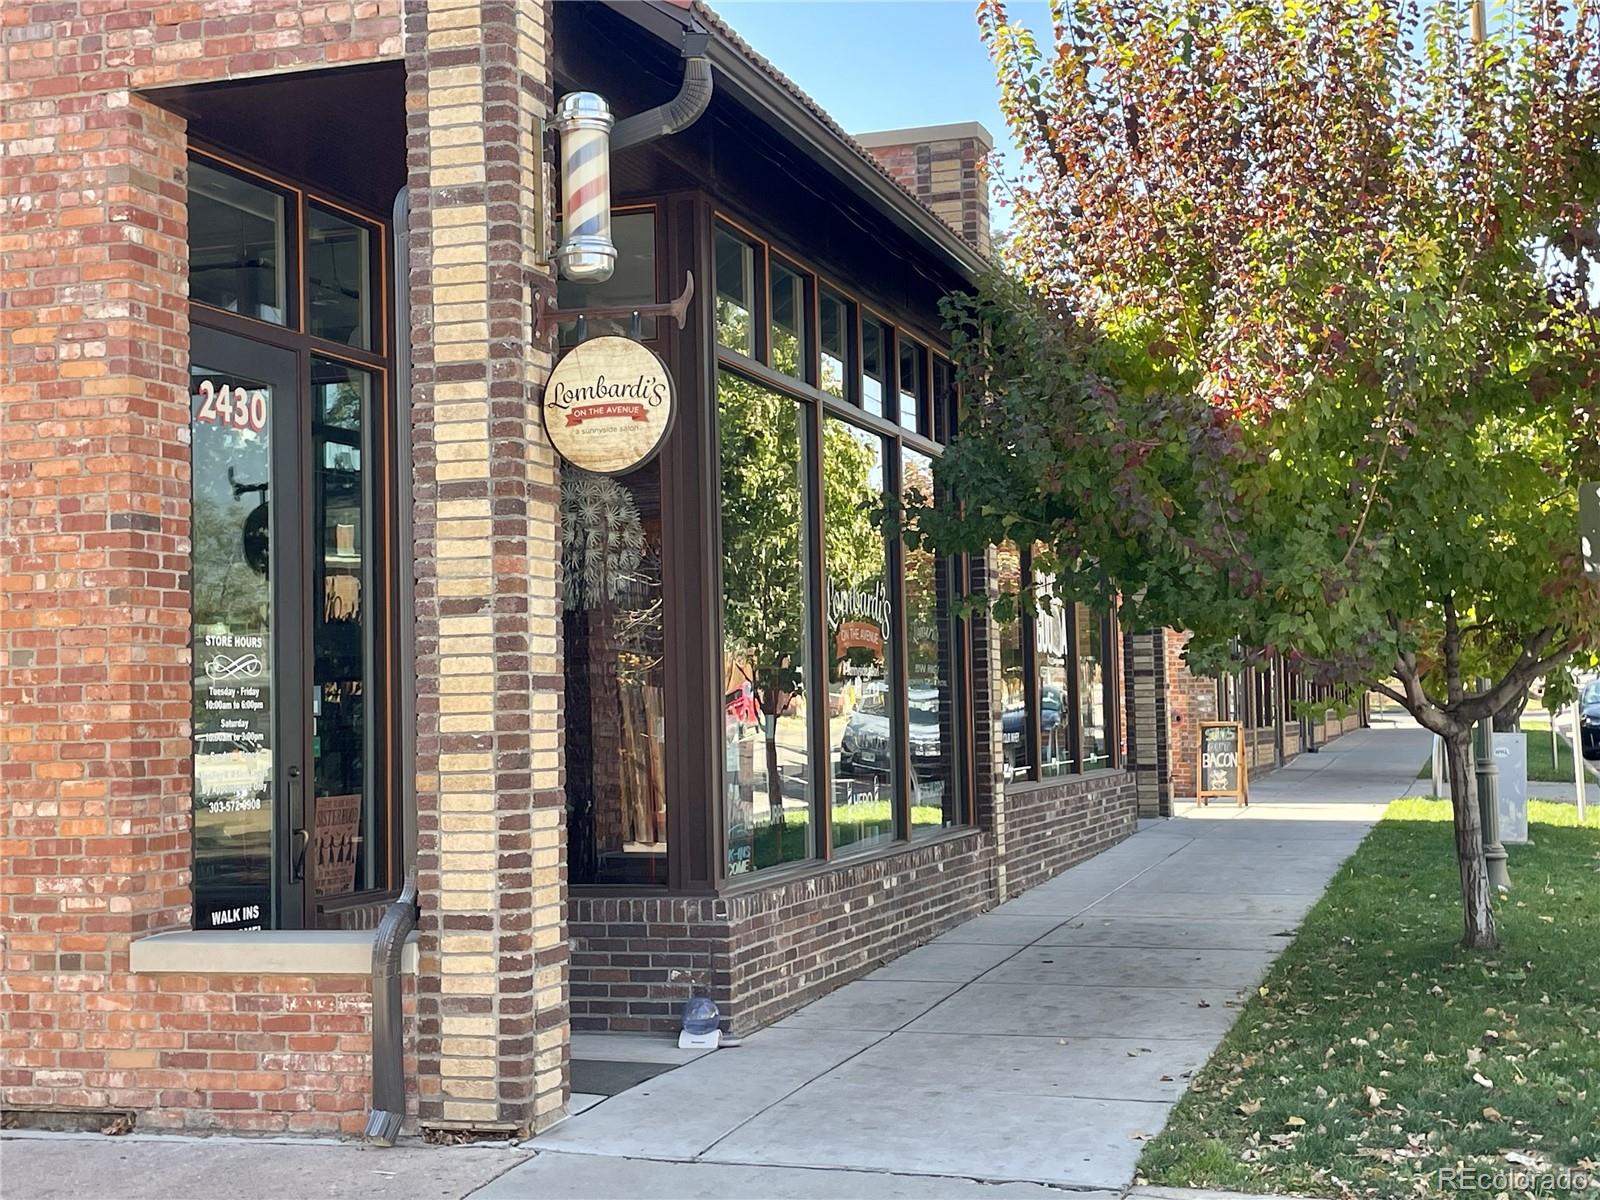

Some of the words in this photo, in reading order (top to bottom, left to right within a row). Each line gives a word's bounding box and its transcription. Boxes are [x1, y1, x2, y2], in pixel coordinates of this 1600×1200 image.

[197, 380, 266, 431] 2430
[574, 408, 587, 417] ON
[589, 407, 604, 415] THE
[607, 405, 640, 414] AVENUE
[581, 426, 618, 435] sunnyside
[620, 424, 639, 433] salon
[205, 635, 233, 647] STORE
[234, 636, 262, 648] HOURS
[841, 629, 850, 642] ON
[850, 628, 860, 640] THE
[860, 629, 879, 644] AVENUE
[209, 686, 236, 698] Tuesday
[240, 686, 260, 698] Friday
[205, 700, 233, 710] 10:00am
[233, 700, 240, 710] to
[241, 700, 264, 711] 6:00pm
[220, 718, 249, 729] Saturday
[1202, 752, 1238, 768] BACON
[211, 908, 241, 926] WALK
[242, 905, 260, 920] INS
